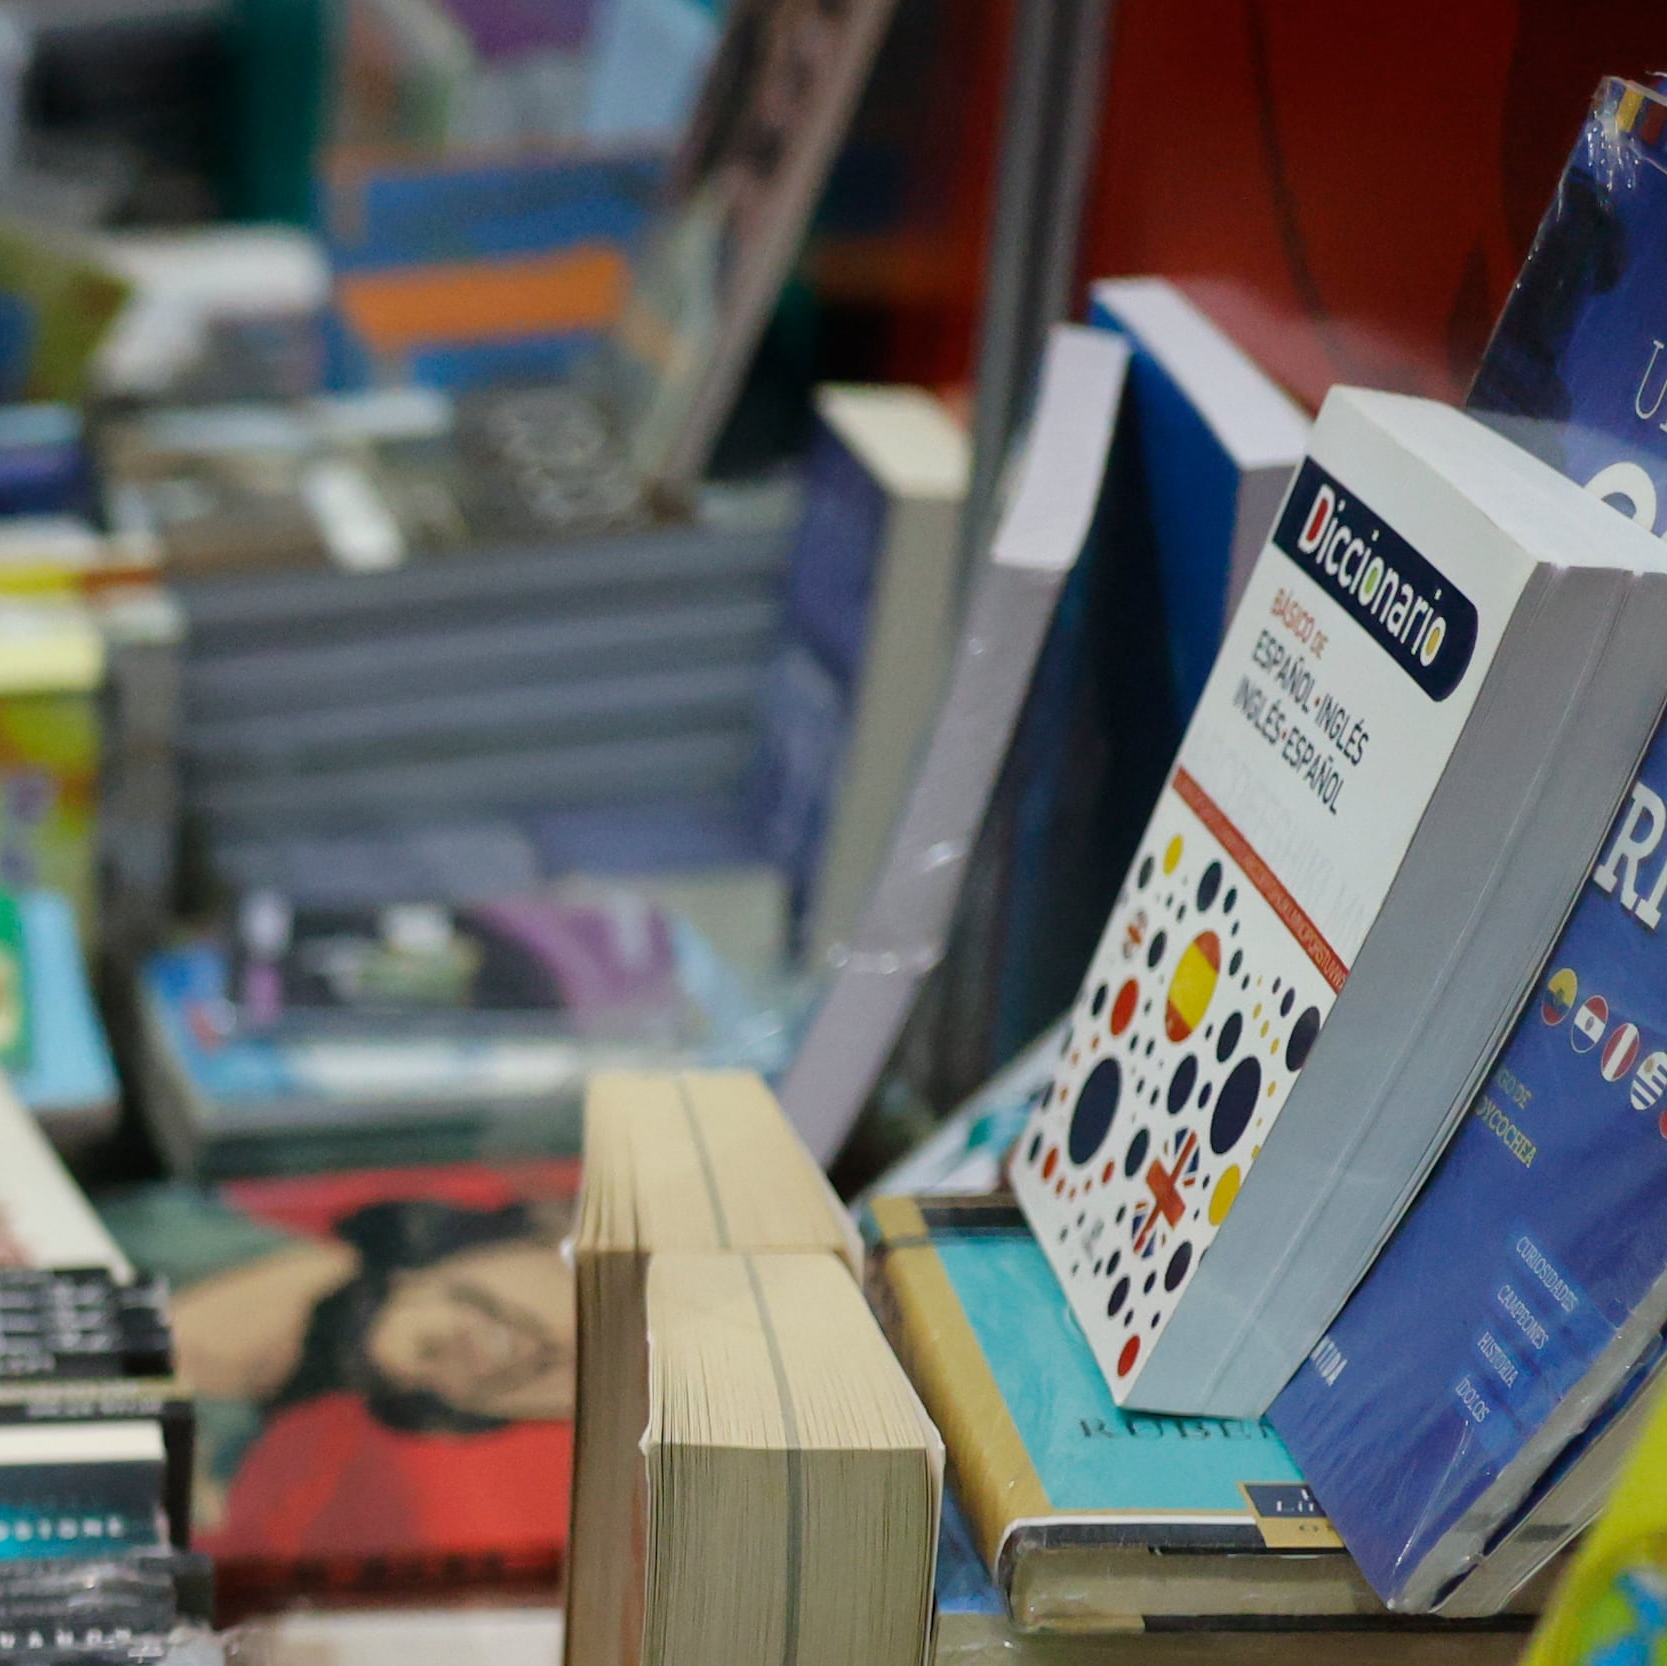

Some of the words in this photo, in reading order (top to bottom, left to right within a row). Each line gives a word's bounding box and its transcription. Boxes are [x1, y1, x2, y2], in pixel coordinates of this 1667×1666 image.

[1298, 484, 1447, 668] Diccionario
[1231, 673, 1285, 746] INGLÉS
[1282, 727, 1348, 815] ESPAÑOL
[1252, 629, 1317, 715] ESPAÑOL
[1316, 690, 1370, 768] INGLÉS
[1496, 1283, 1550, 1351] CAMPEONES
[1516, 1234, 1579, 1314] CURIOSIDADES
[1476, 1331, 1520, 1390] HISTORIA
